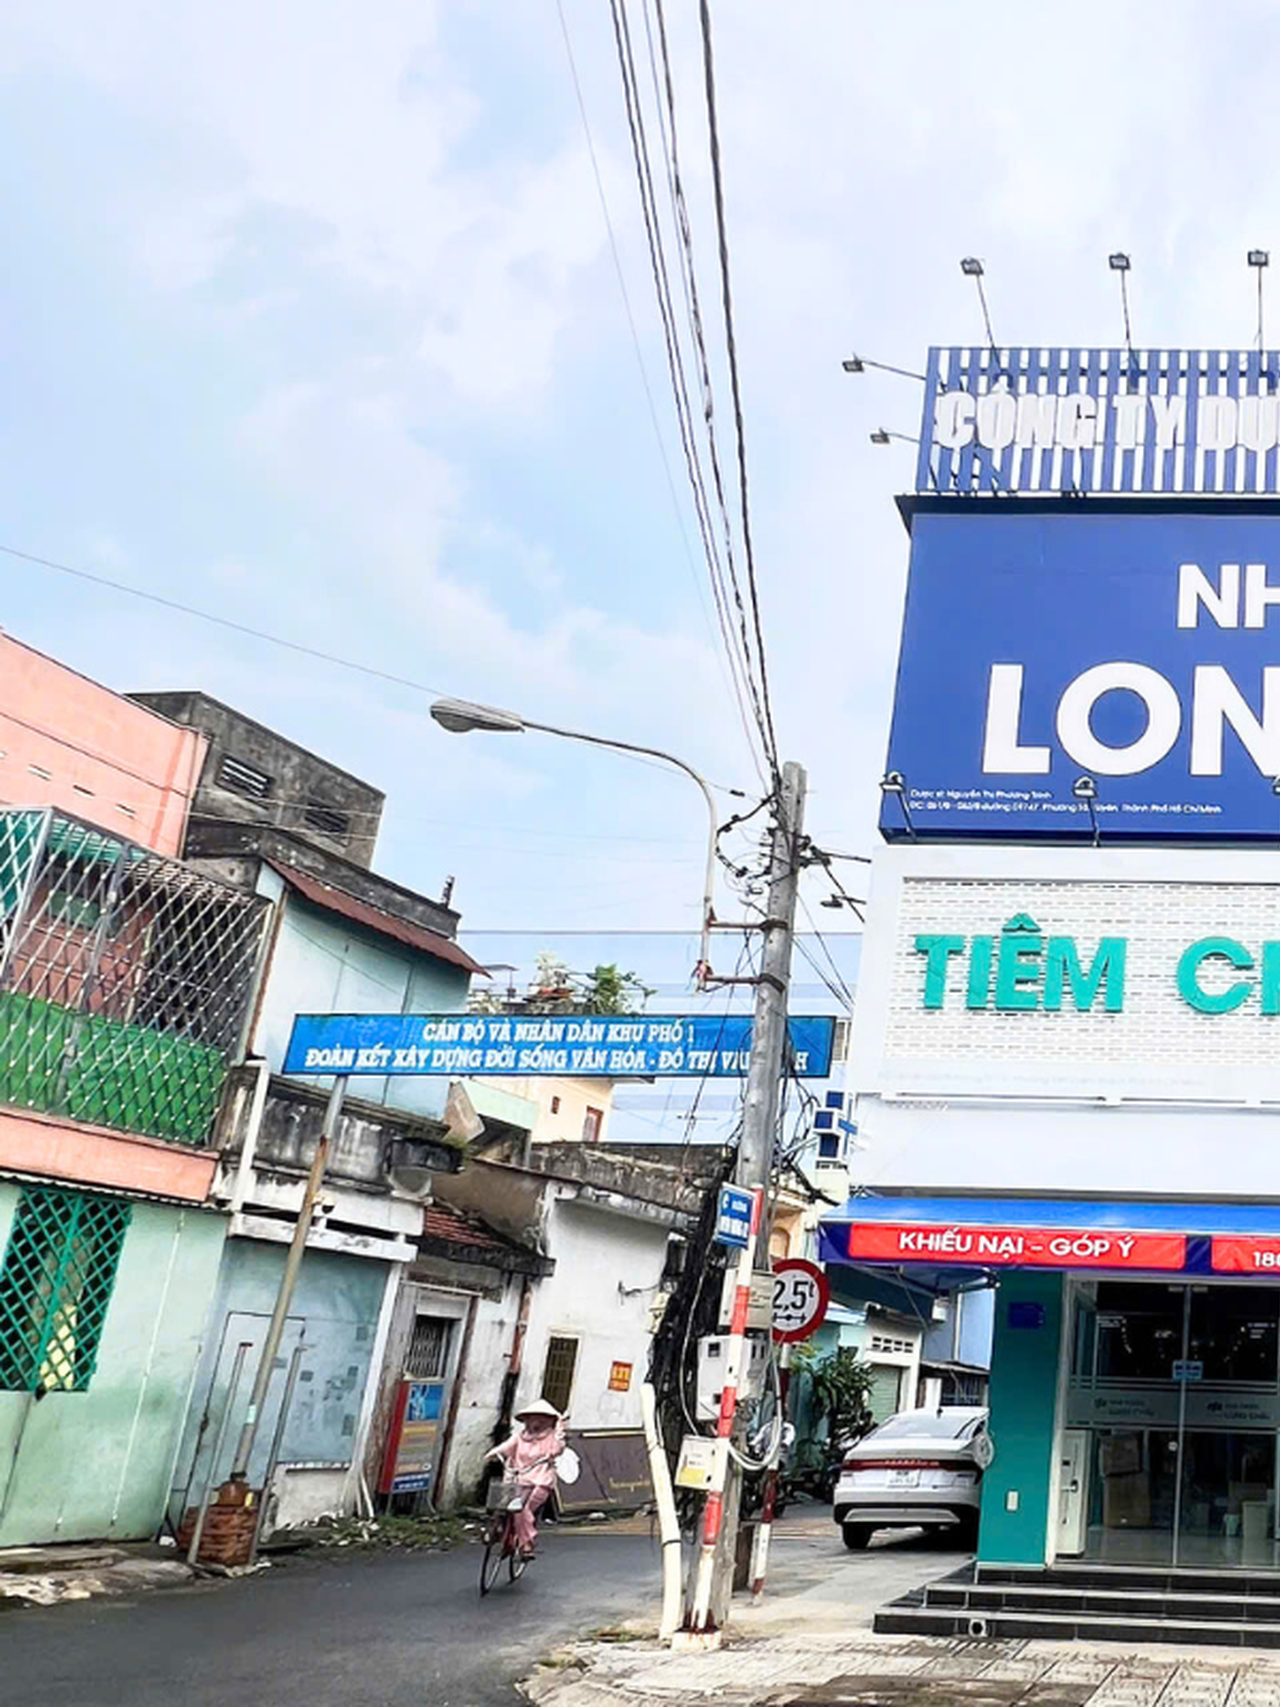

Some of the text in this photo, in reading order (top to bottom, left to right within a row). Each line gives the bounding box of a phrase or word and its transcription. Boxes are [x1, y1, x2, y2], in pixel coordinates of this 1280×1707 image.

[934, 381, 1098, 450] CÔNG
[1113, 394, 1187, 450] TY
[914, 913, 1128, 1013] TIÊM
[422, 1018, 460, 1042] CÁN
[461, 1019, 486, 1045] BỘ
[489, 1018, 512, 1042] VÀ
[514, 1019, 565, 1042] NHÂN
[566, 1019, 606, 1043] DÂN
[606, 1023, 646, 1043] KHU
[647, 1018, 684, 1043] PHỐ
[304, 1043, 356, 1068] ĐOÀN
[355, 1041, 392, 1068] KẾT
[391, 1044, 432, 1068] XÂY
[431, 1046, 483, 1071] DỰNG
[484, 1045, 516, 1069] ĐỜI
[518, 1043, 568, 1069] SỐNG
[571, 1046, 608, 1070] VĂN
[609, 1044, 647, 1070] HÓA
[658, 1045, 685, 1070] ĐÔ
[687, 1050, 719, 1075] THỊ
[899, 1227, 972, 1253] KHIẾU
[978, 1237, 1024, 1259] NẠI
[1049, 1234, 1111, 1258] GÓP
[1116, 1236, 1136, 1258] Ý
